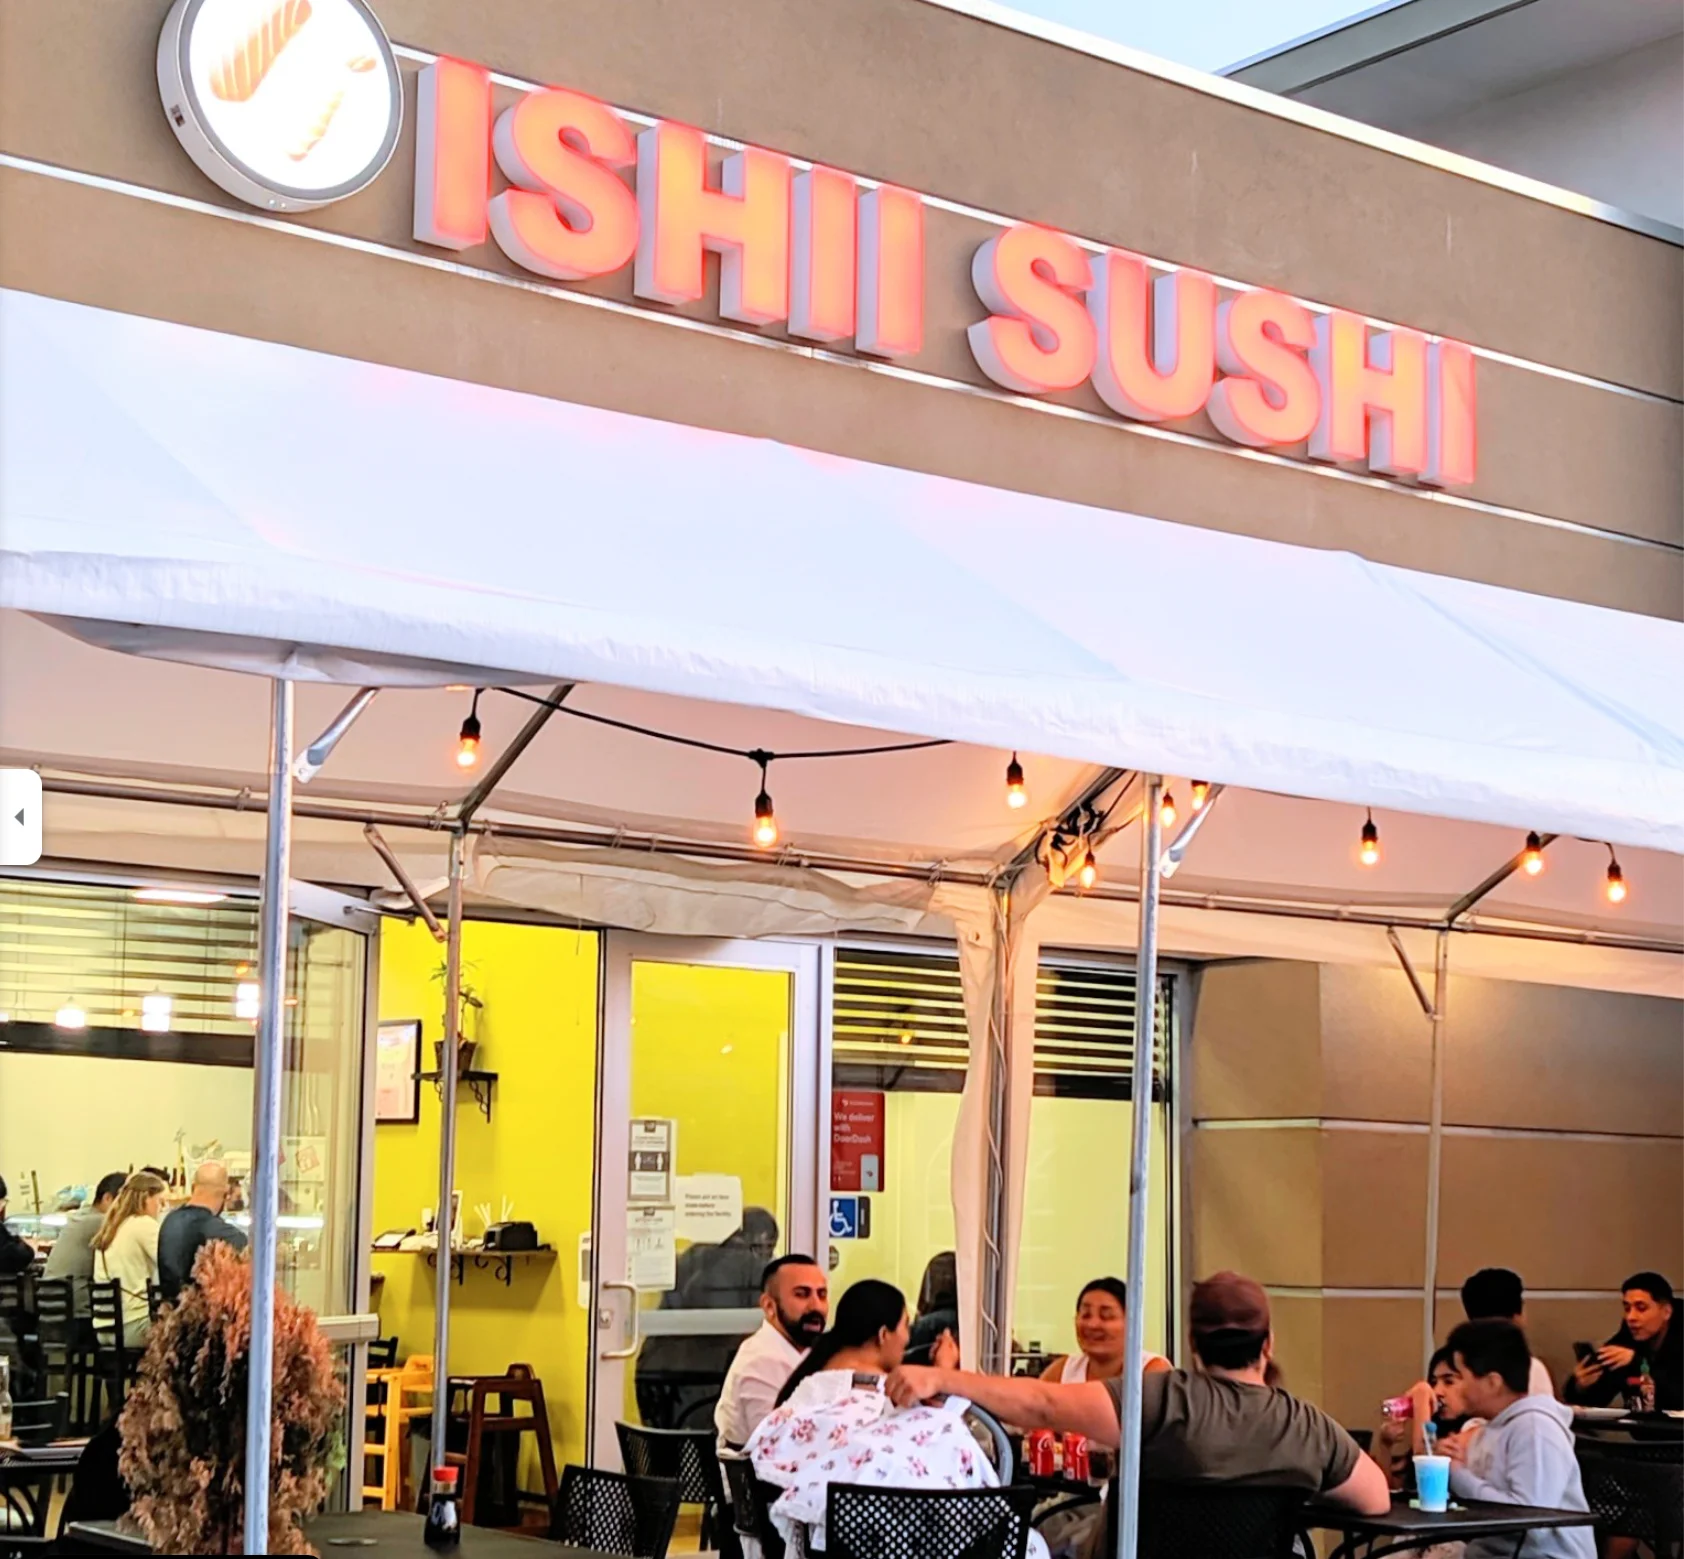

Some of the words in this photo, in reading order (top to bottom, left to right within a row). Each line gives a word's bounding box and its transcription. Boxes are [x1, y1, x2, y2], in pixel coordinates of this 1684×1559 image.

[414, 56, 924, 357] ISHII
[968, 221, 1476, 487] SUSHI
[834, 1112, 848, 1121] We
[849, 1112, 875, 1122] deliver
